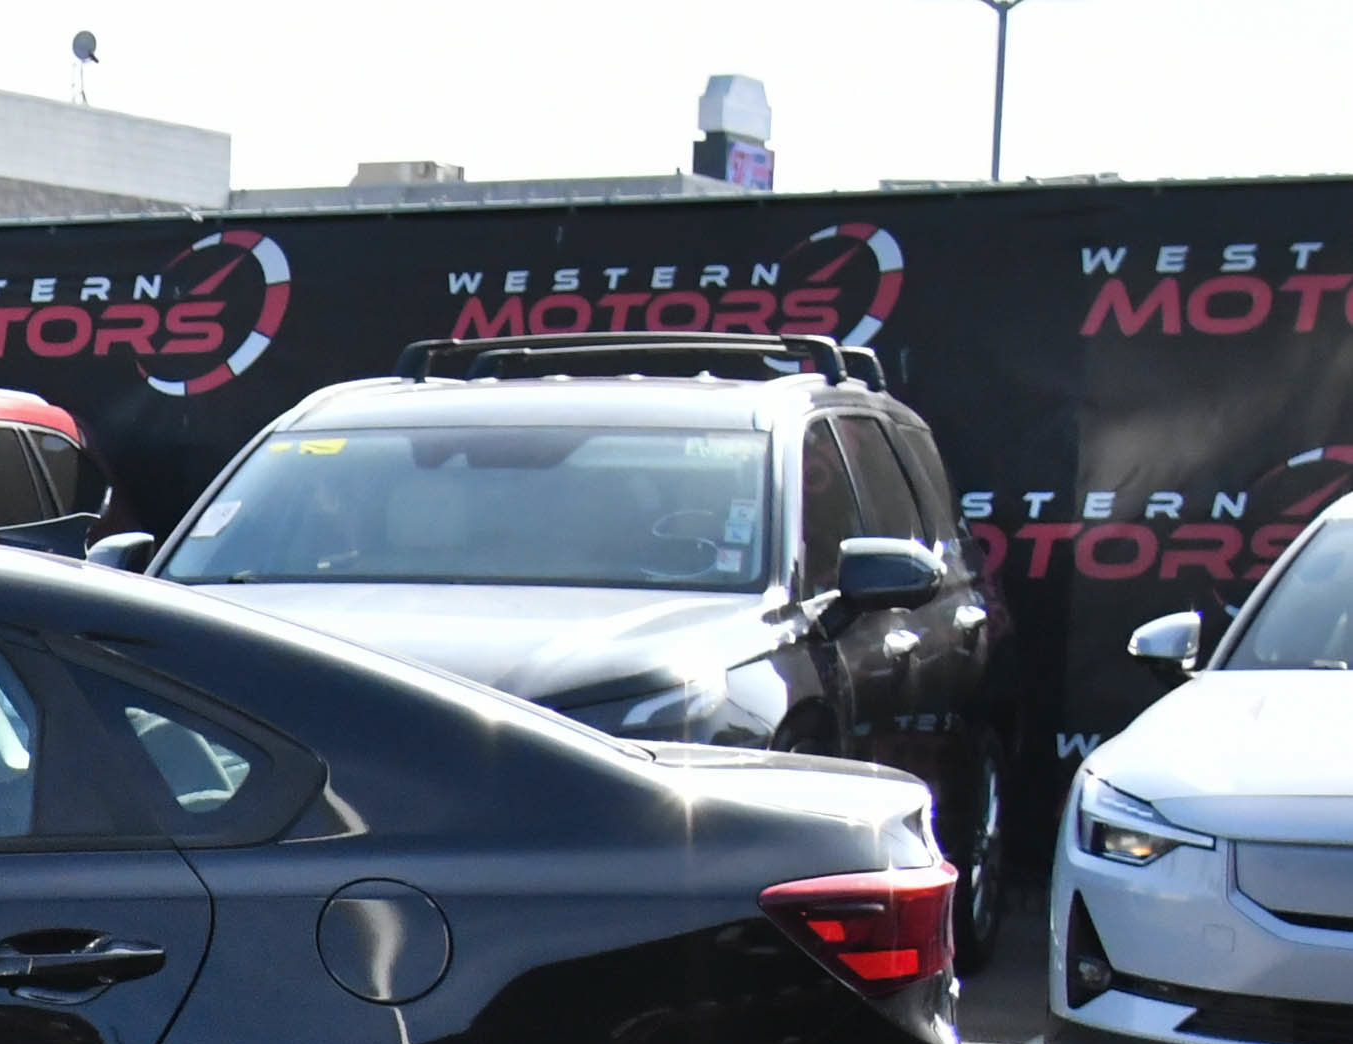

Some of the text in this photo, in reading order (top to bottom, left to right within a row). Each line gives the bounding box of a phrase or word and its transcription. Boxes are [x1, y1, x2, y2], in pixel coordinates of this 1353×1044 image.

[1080, 242, 1324, 276] WEST
[448, 263, 780, 295] WESTERN
[451, 288, 840, 340] MOTORS
[1080, 273, 1353, 336] MOT
[961, 490, 1249, 520] STERN
